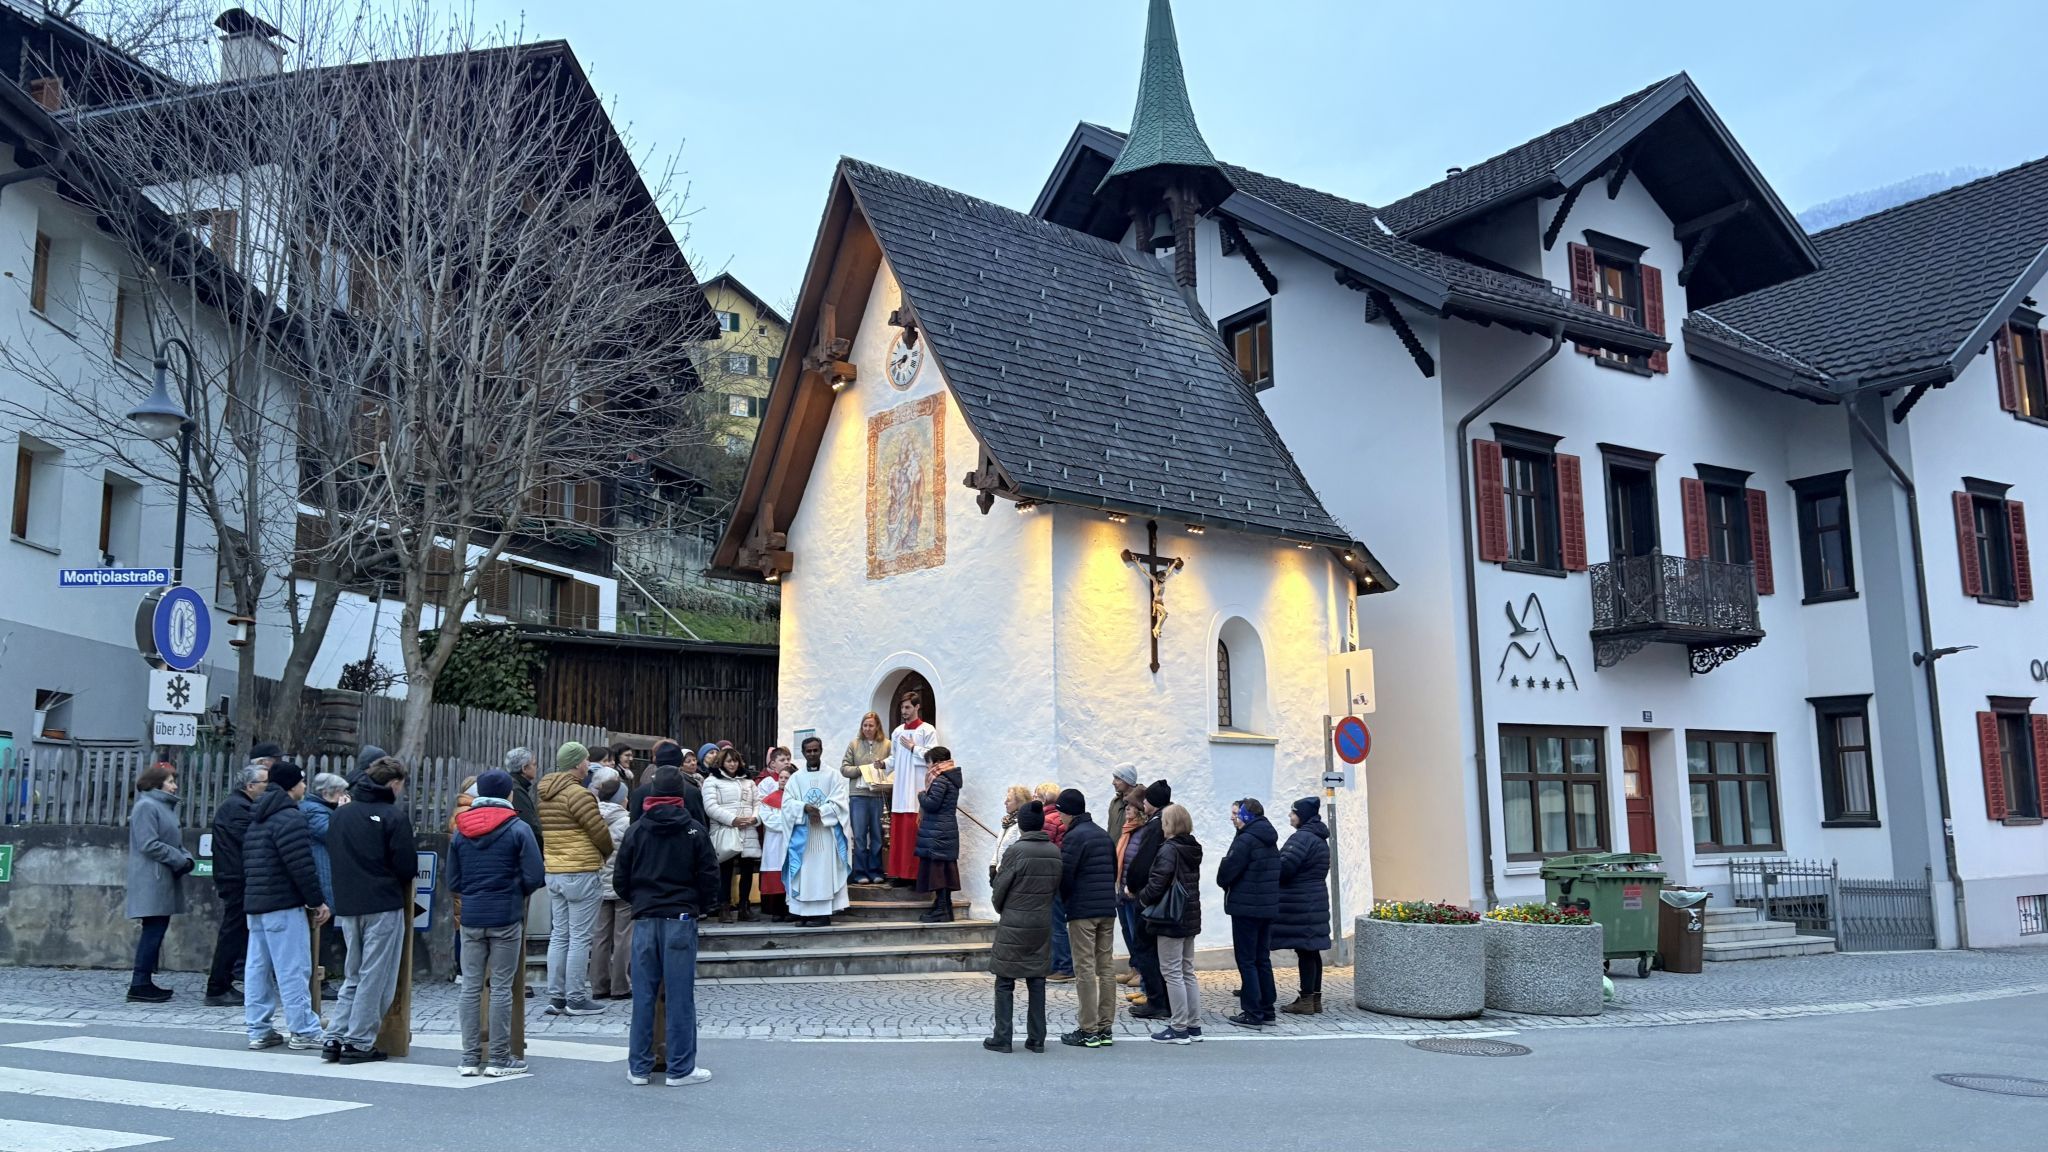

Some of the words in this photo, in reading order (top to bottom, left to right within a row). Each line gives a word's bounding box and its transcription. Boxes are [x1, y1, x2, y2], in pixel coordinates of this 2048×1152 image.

[64, 570, 165, 585] Montjolastraße
[155, 721, 176, 736] über
[179, 723, 196, 738] 3,5t
